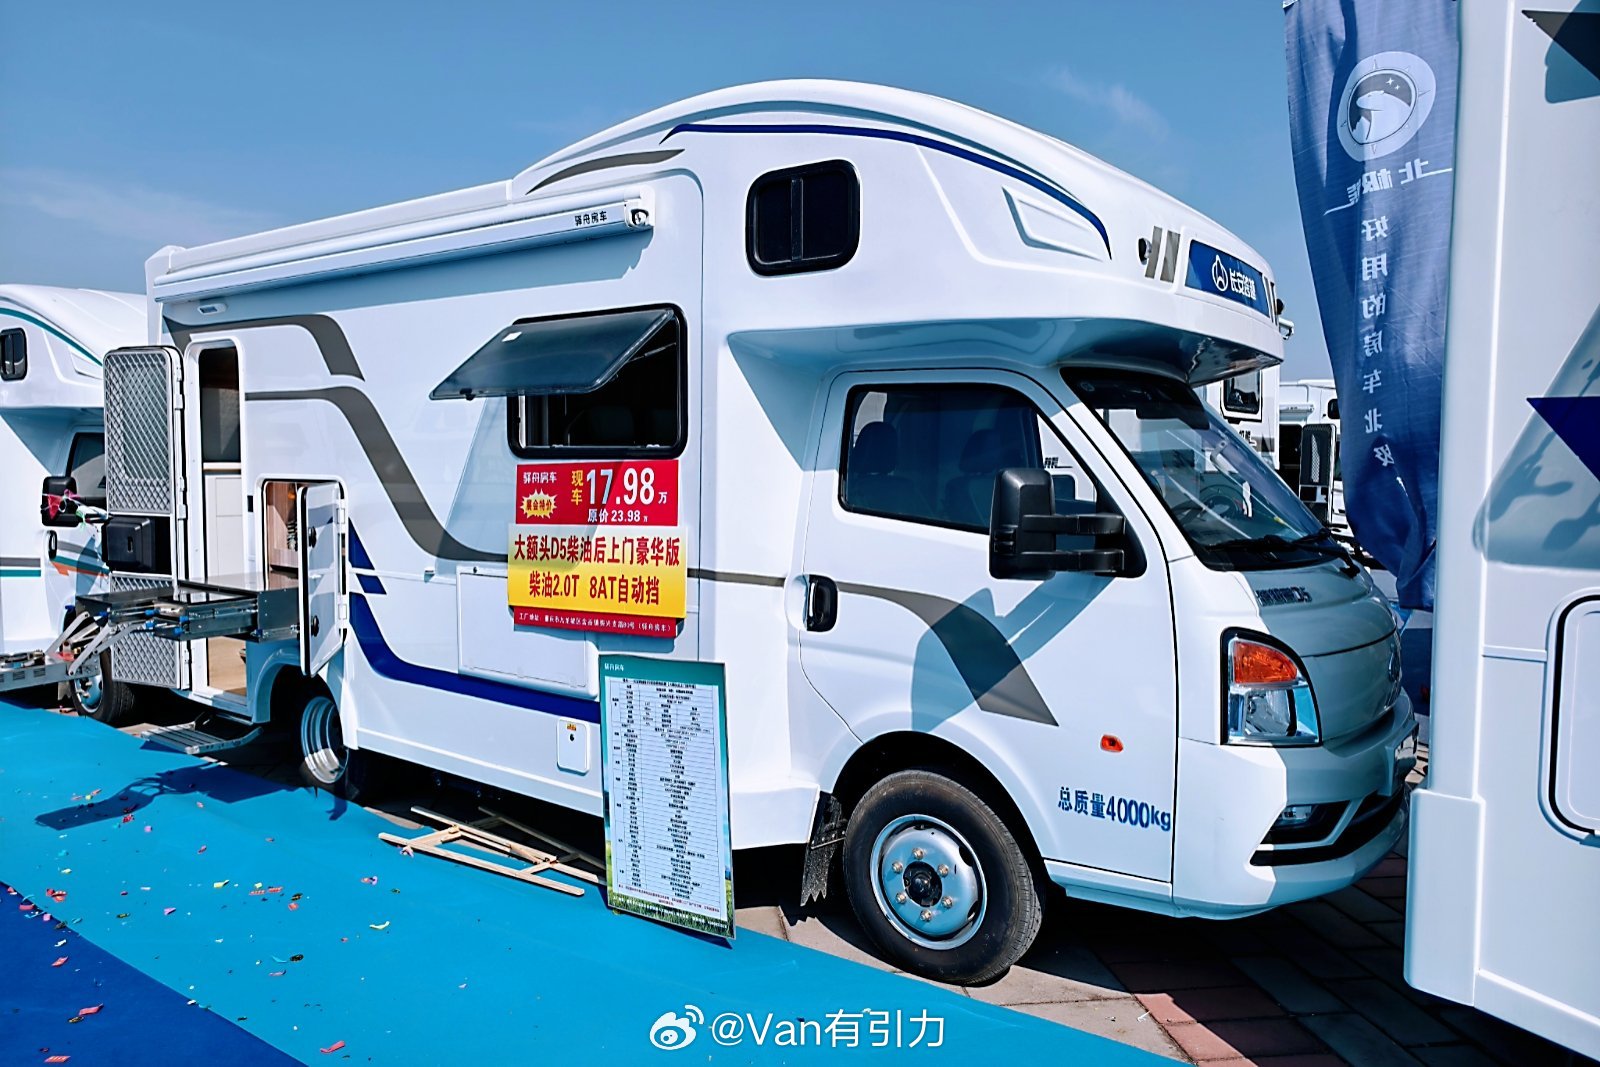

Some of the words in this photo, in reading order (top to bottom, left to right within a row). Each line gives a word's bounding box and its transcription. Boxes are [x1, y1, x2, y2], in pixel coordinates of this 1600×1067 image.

[586, 467, 655, 505] 17.98
[658, 491, 668, 504] 万
[587, 508, 609, 523] 原价
[611, 509, 641, 522] 23.98
[514, 533, 680, 567] 大额头D5柴油后上门豪华版
[529, 570, 580, 598] 柴油2.0T
[589, 573, 660, 605] 8AT自动挡
[1058, 786, 1171, 831] 总质量4000kg
